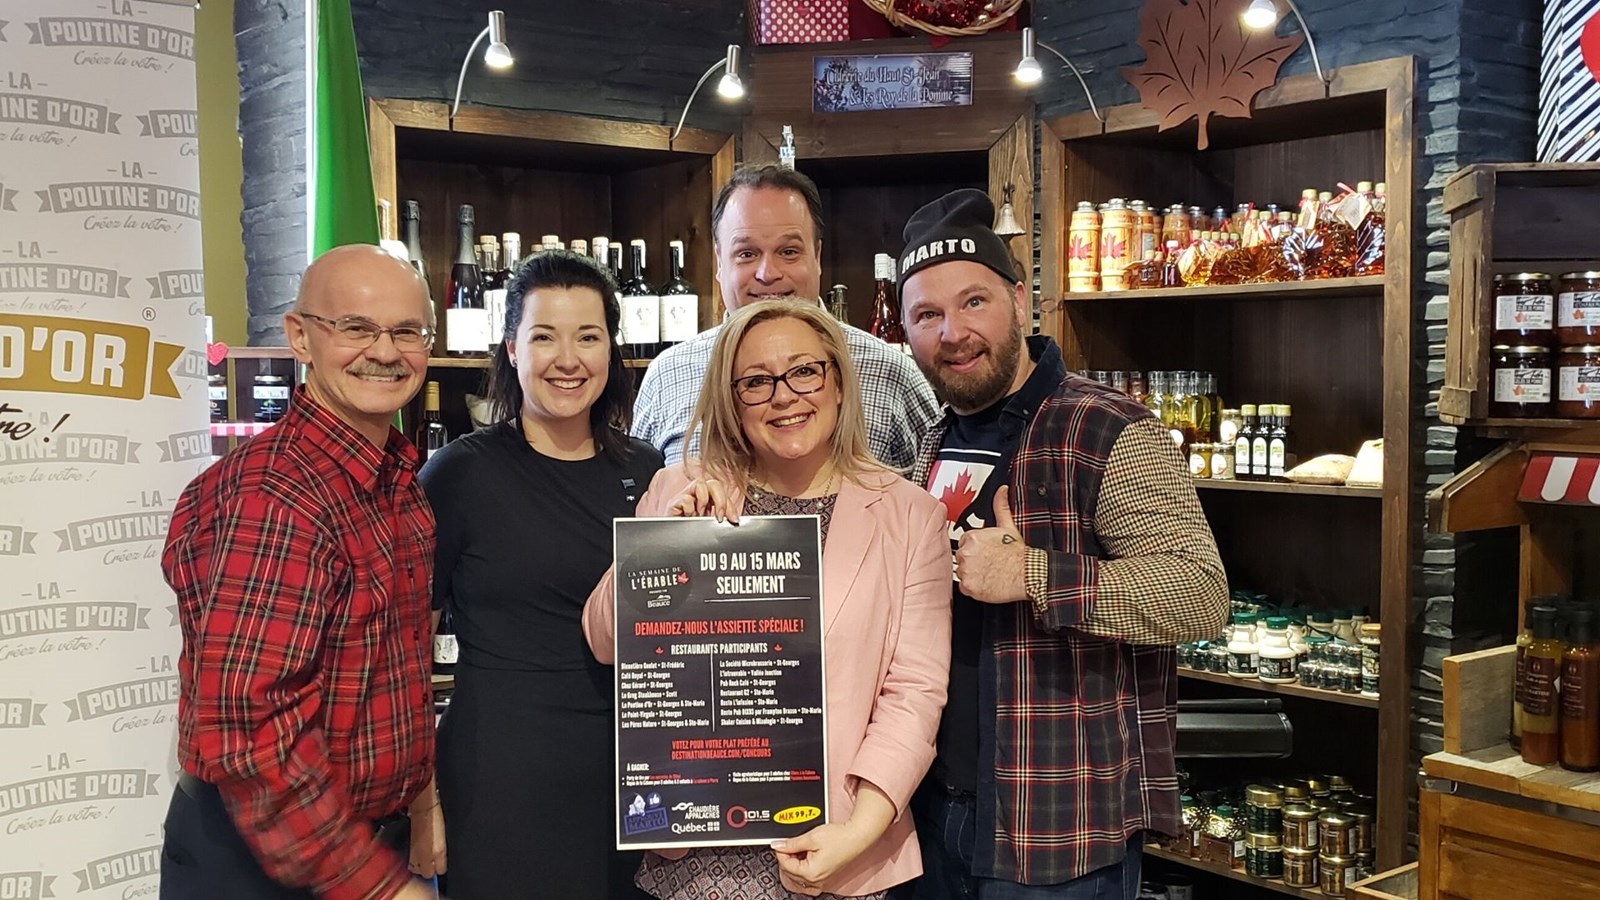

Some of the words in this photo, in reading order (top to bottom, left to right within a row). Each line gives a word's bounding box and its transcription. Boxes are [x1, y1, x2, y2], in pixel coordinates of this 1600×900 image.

[111, 0, 133, 17] LA
[50, 21, 140, 46] POUTINE
[147, 27, 194, 57] D'OR
[113, 51, 128, 66] la
[8, 71, 32, 90] LA
[47, 101, 99, 129] D'OR
[121, 161, 143, 179] LA
[57, 186, 149, 209] POUTINE
[156, 190, 200, 217] D'OR
[123, 215, 137, 230] la
[18, 241, 42, 259] LA
[902, 239, 976, 275] MARTO
[57, 268, 108, 294] D'OR
[0, 326, 127, 388] D'OR
[66, 437, 118, 460] D'OR
[141, 490, 163, 508] LA
[77, 514, 168, 546] POUTINE
[700, 552, 716, 571] DU
[719, 553, 728, 571] 9
[730, 553, 746, 571] AU
[749, 552, 763, 571] 15
[766, 551, 801, 570] MARS
[639, 567, 669, 576] SEMAINE
[37, 582, 60, 600] LA
[631, 574, 678, 590] L'ÉRABLE
[716, 575, 786, 595] SEULEMENT
[647, 600, 671, 609] Beauce
[75, 606, 128, 627] D'OR
[635, 622, 708, 636] DEMANDEZ-NOUS
[709, 620, 756, 634] L'ASSIETTE
[758, 617, 799, 633] SPÉCIALE
[671, 643, 718, 655] RESTAURANTS
[720, 642, 768, 654] PARTICIPANTS
[151, 655, 172, 673] LA
[647, 671, 670, 680] St-Georges
[753, 679, 777, 687] St-Georges
[650, 681, 673, 689] St-Georges
[86, 679, 178, 715] POUTINE
[657, 701, 680, 709] St-Georges
[659, 711, 682, 719] St-Georges
[661, 720, 684, 728] St-Georges
[780, 718, 804, 726] St-Georges
[672, 740, 689, 750] VOTEZ
[690, 740, 704, 749] POUR
[705, 739, 722, 749] VOTRE
[723, 739, 736, 748] PLAT
[737, 737, 760, 748] PRÉFÉRÉ
[761, 738, 769, 747] AU
[47, 752, 71, 772] LA
[85, 773, 137, 797] D'OR
[685, 812, 720, 820] APPALACHES
[689, 804, 720, 813] CHAUDIÈRE
[778, 812, 794, 821] MIX
[671, 822, 707, 835] Québec
